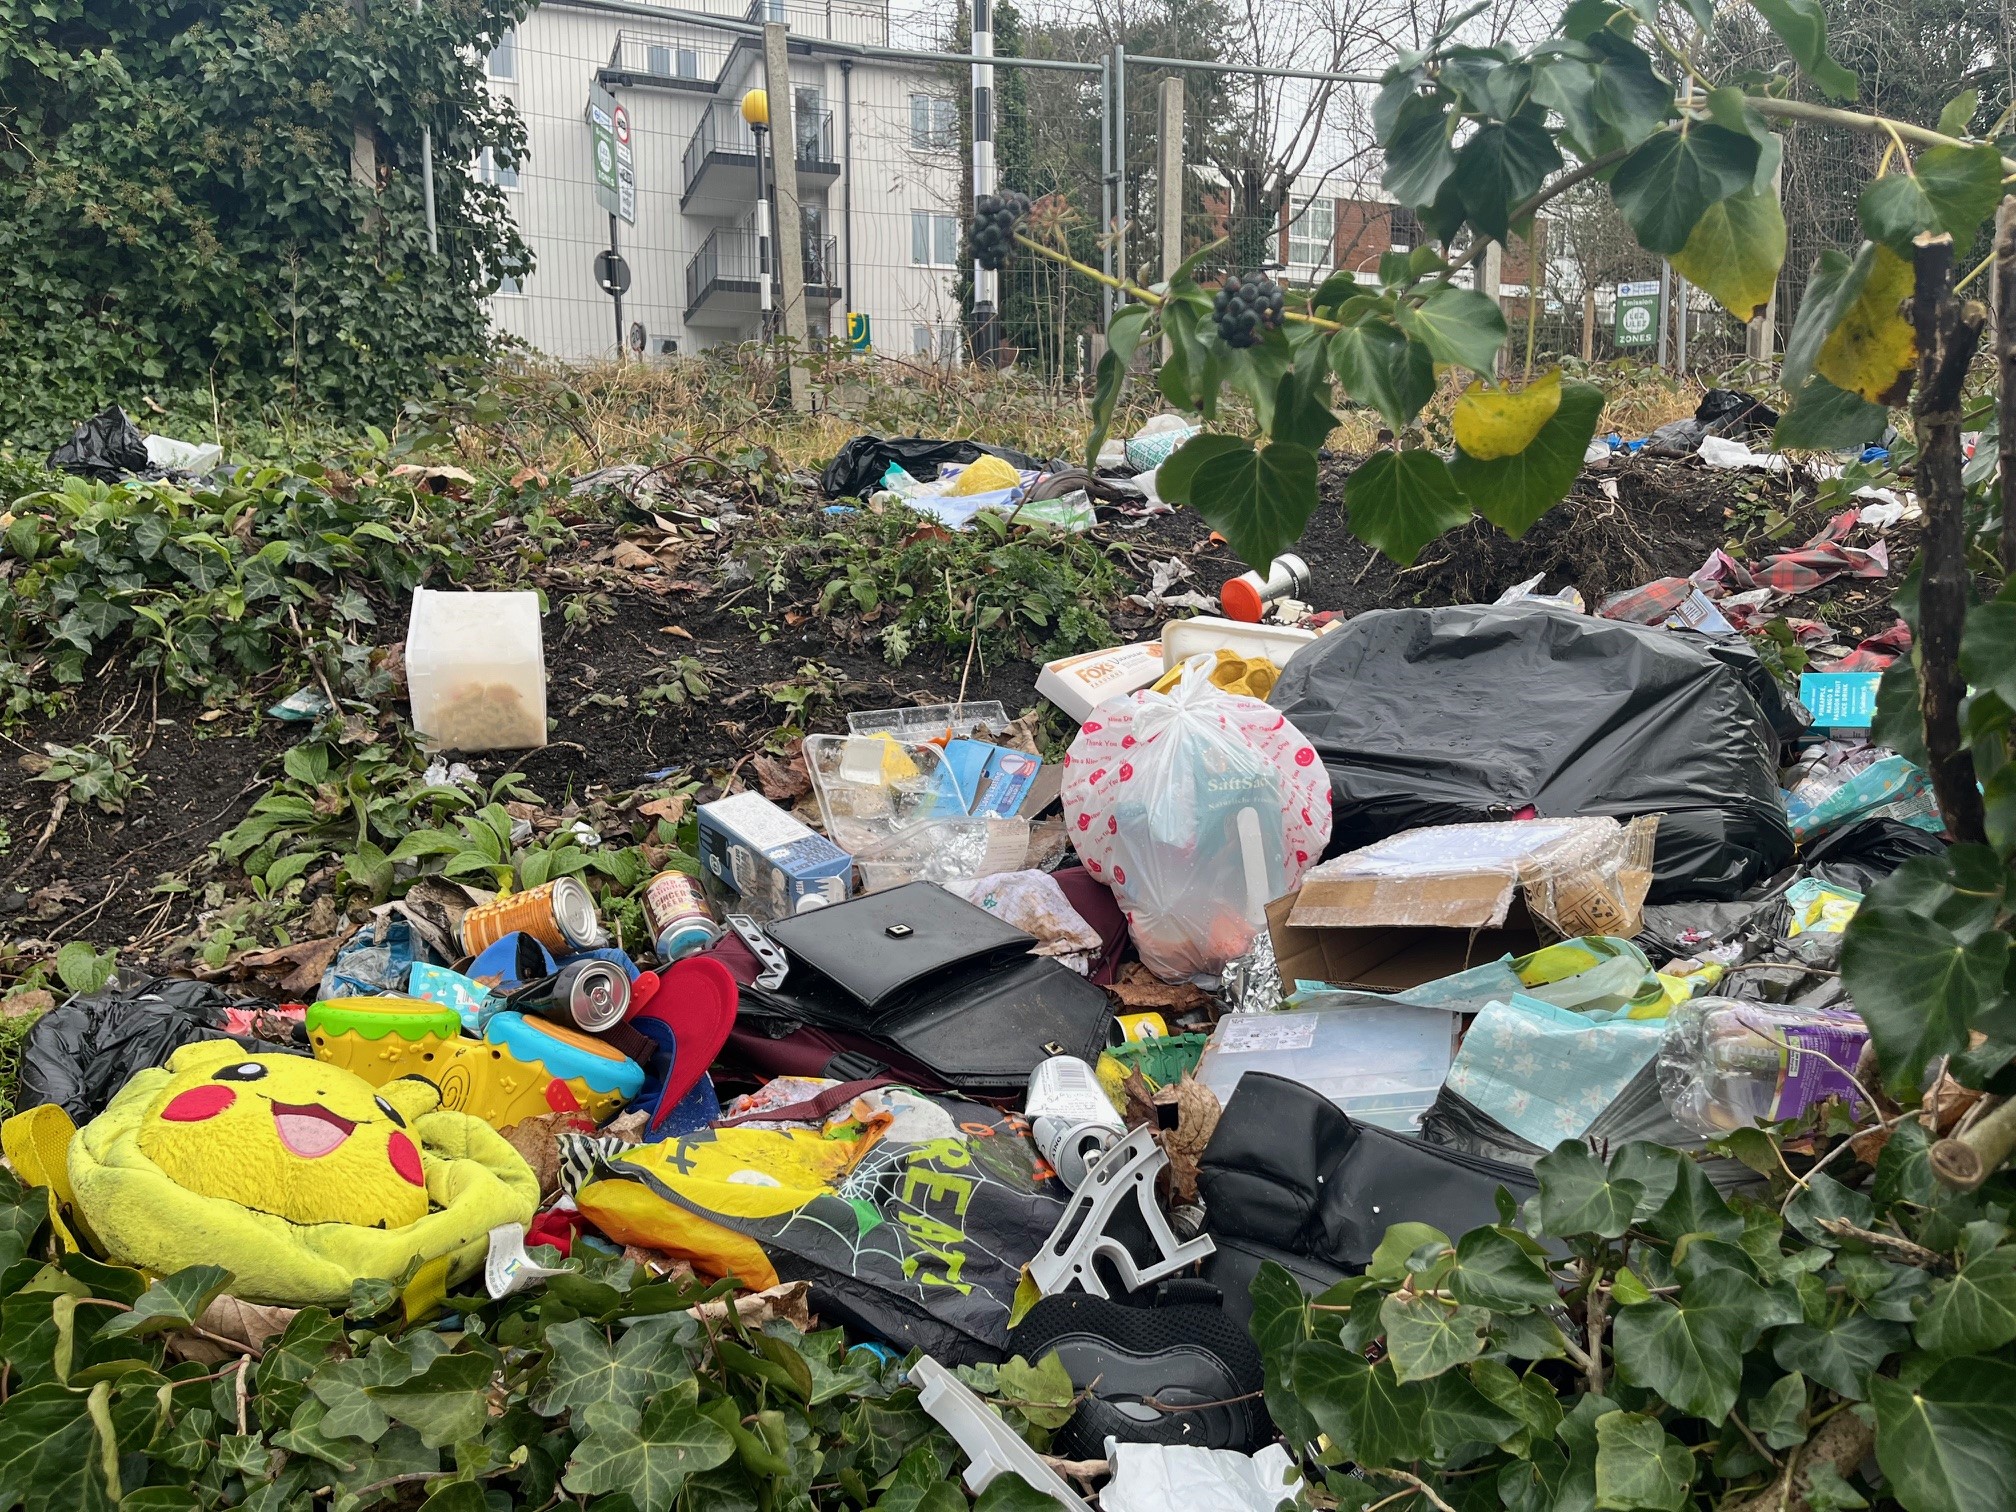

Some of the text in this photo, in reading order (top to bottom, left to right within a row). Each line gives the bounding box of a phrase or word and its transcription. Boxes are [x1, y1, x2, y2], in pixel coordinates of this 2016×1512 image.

[1630, 312, 1645, 320] LEZ
[1619, 334, 1652, 344] ZONES
[1834, 680, 1842, 697] FRUIT
[1841, 683, 1849, 702] DRINK
[1826, 694, 1834, 714] MANGO
[1086, 738, 1118, 747] Thank You
[655, 889, 688, 908] GINGER
[661, 897, 685, 911] BEER
